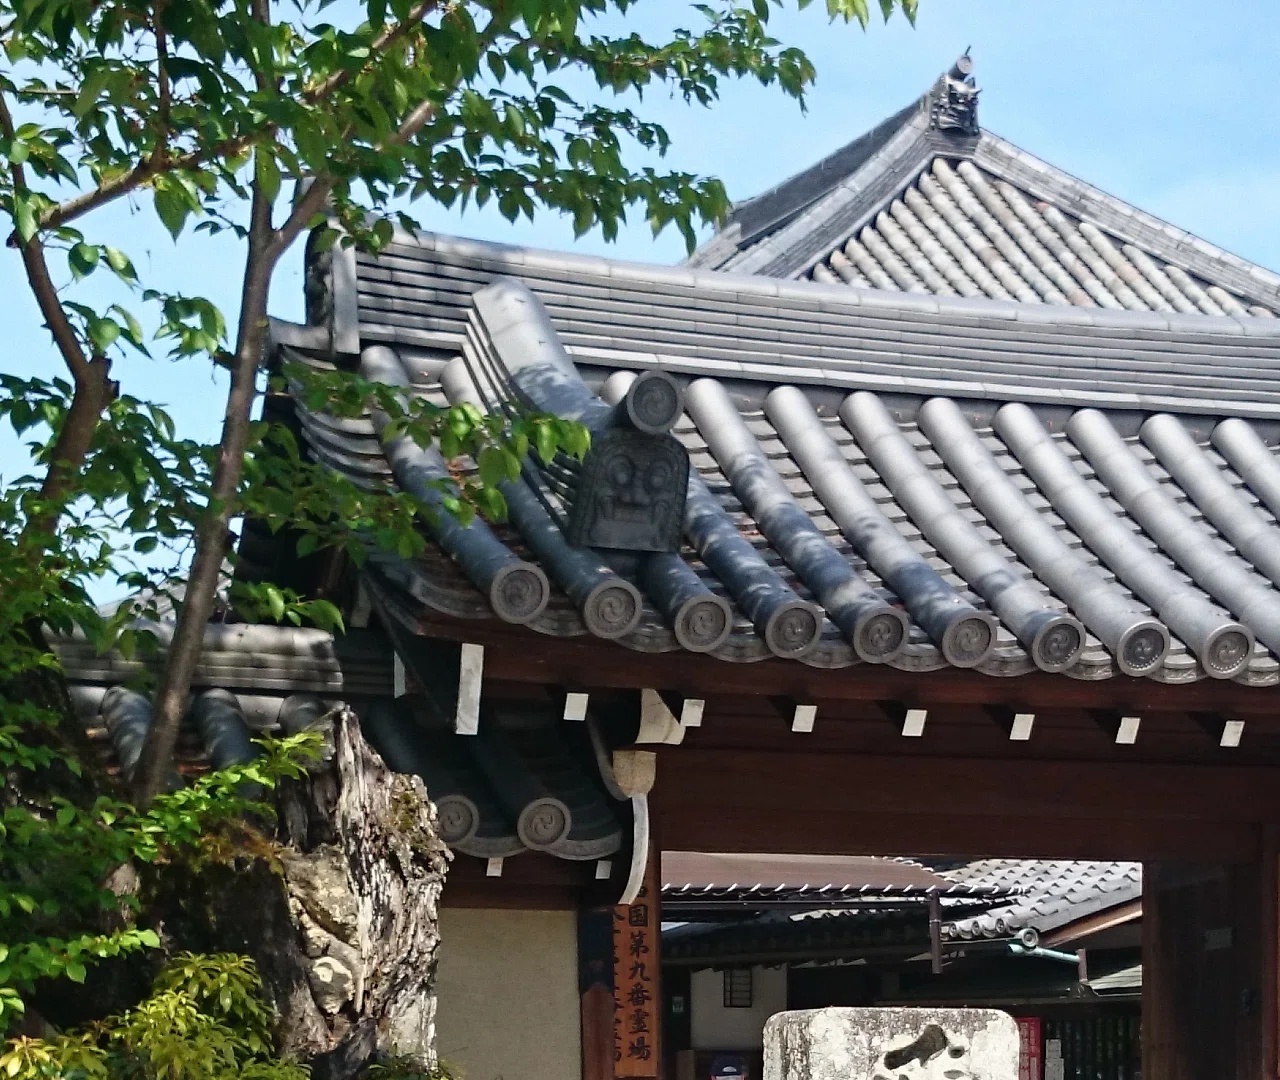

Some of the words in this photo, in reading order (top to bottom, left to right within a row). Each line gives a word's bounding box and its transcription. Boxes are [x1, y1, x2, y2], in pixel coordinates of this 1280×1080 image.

[627, 885, 652, 1061] 国第九番霊場
